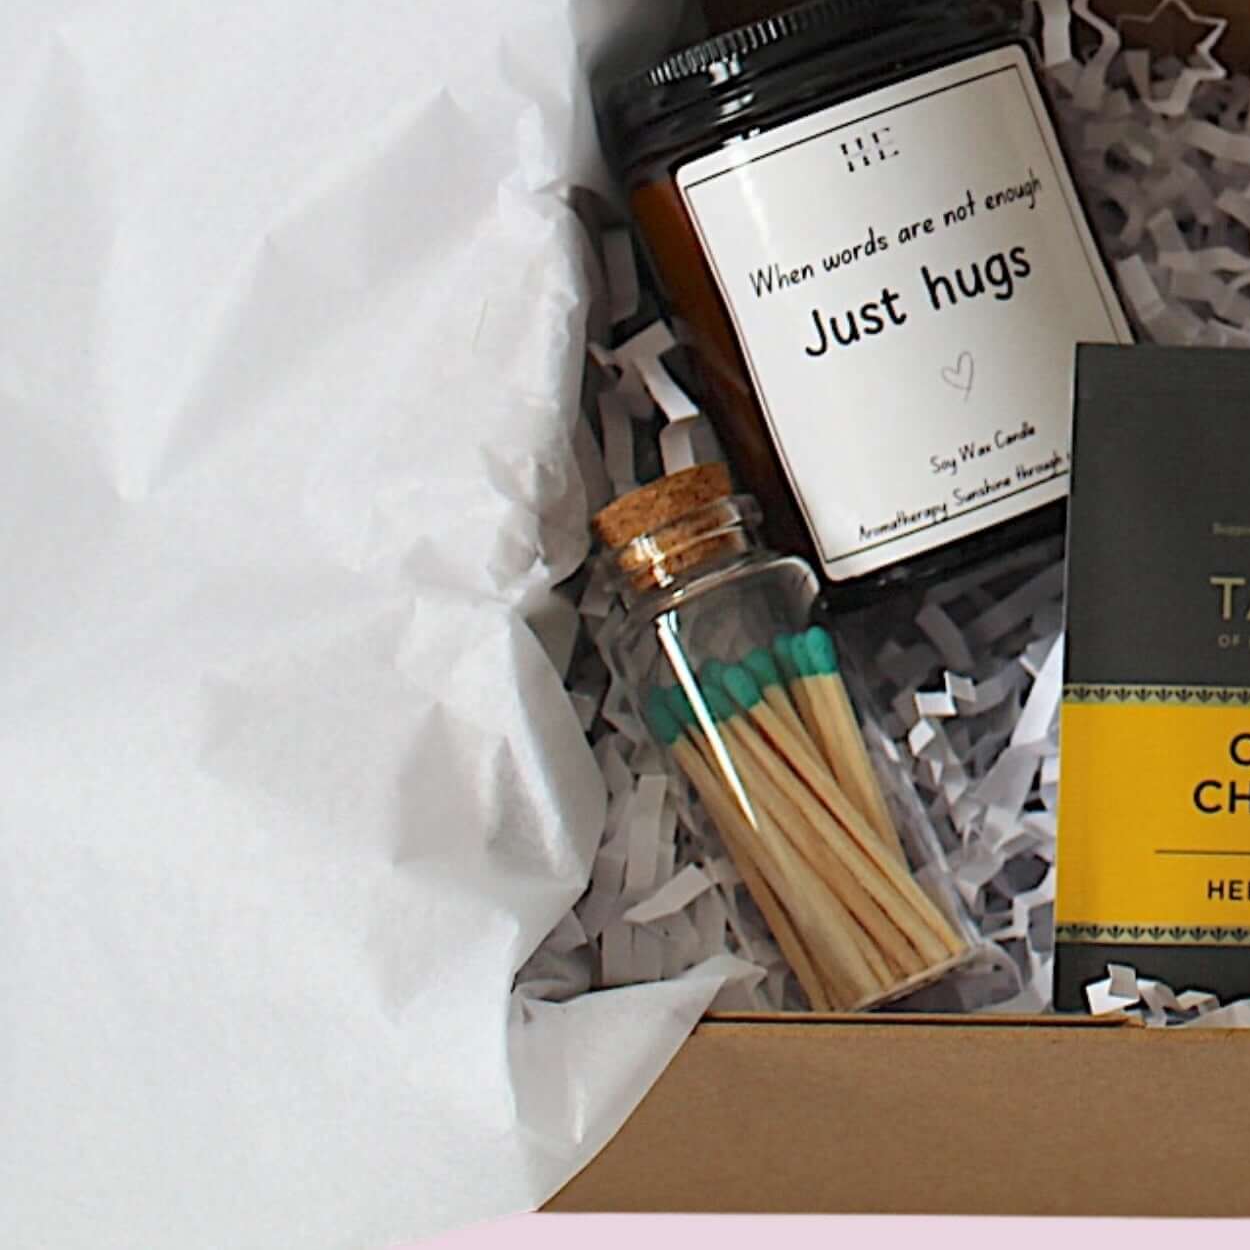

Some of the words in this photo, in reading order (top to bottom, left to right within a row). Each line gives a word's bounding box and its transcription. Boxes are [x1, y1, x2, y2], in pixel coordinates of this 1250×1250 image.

[749, 264, 815, 297] When
[823, 227, 888, 272] words
[898, 218, 935, 244] are
[943, 190, 976, 226] not
[985, 167, 1042, 210] enough
[804, 288, 908, 357] Just
[920, 246, 1031, 310] hugs
[929, 455, 958, 476] Soy
[994, 421, 1036, 449] Candle
[858, 502, 949, 541] Aromatherapy
[953, 476, 1011, 506] Sunshine
